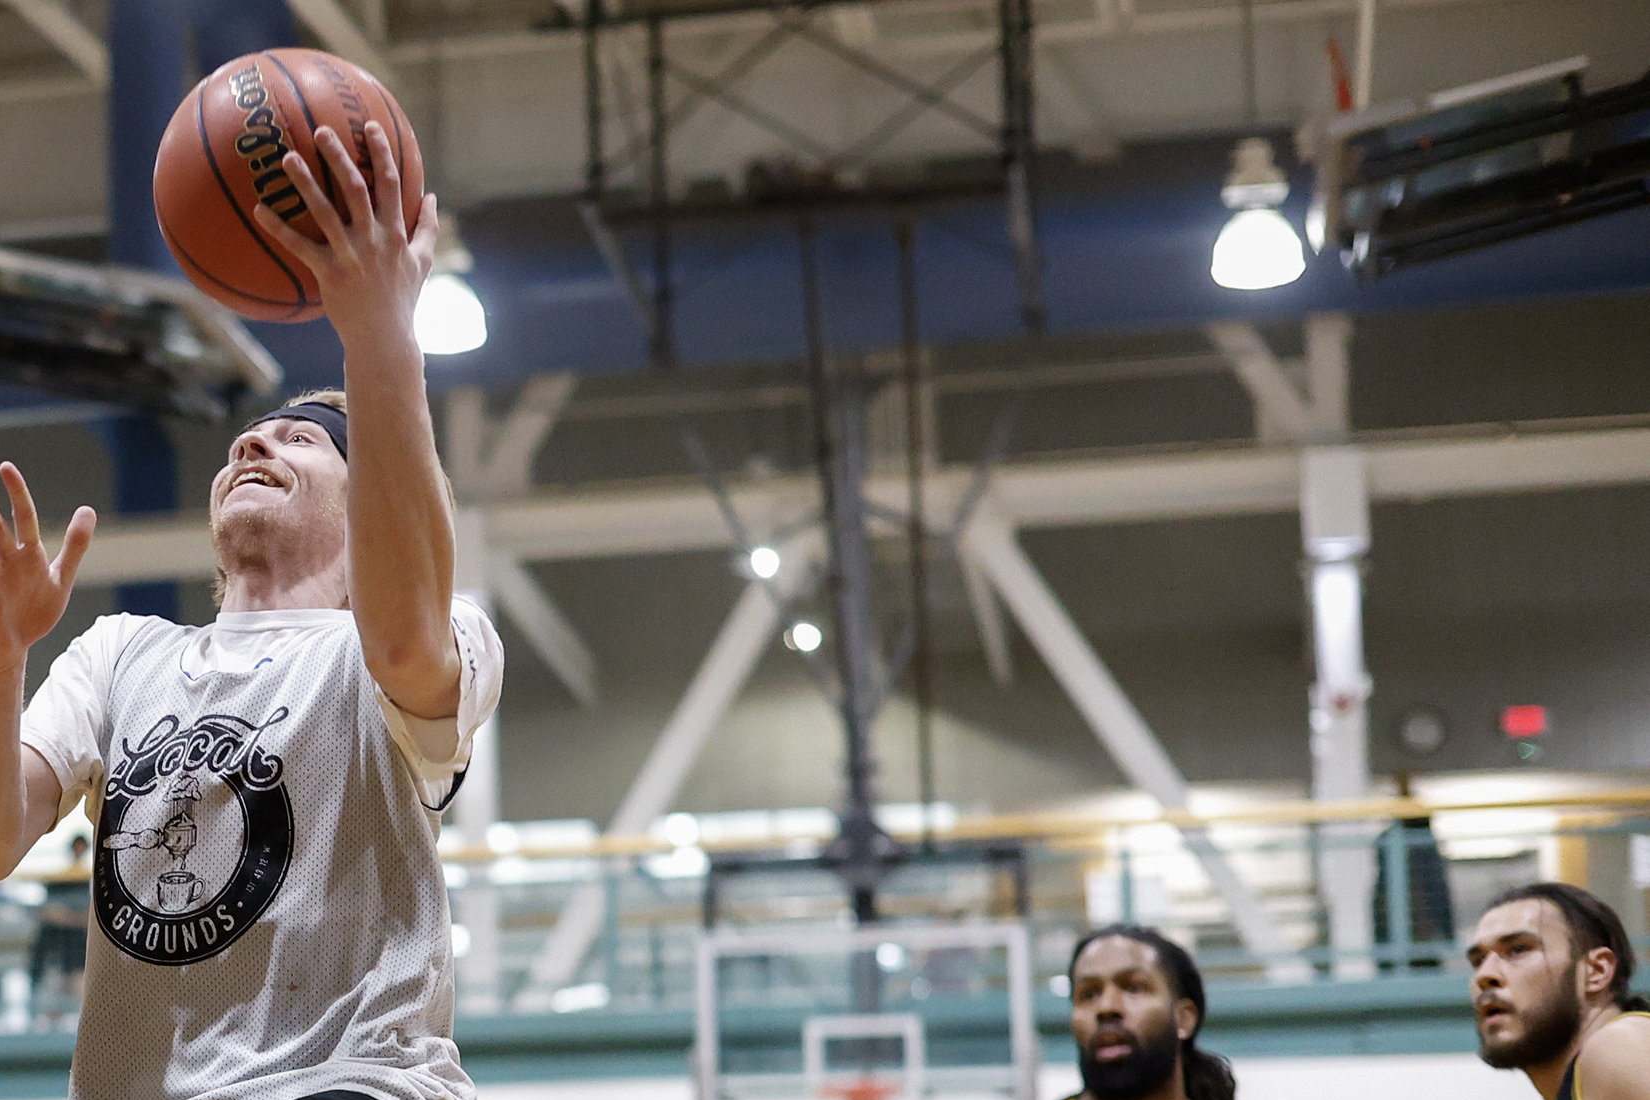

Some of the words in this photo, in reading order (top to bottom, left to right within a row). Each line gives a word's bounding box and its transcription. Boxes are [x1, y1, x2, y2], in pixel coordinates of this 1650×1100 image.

[229, 62, 309, 222] Wilson
[105, 706, 289, 798] Local
[111, 904, 235, 954] GROUNDS
